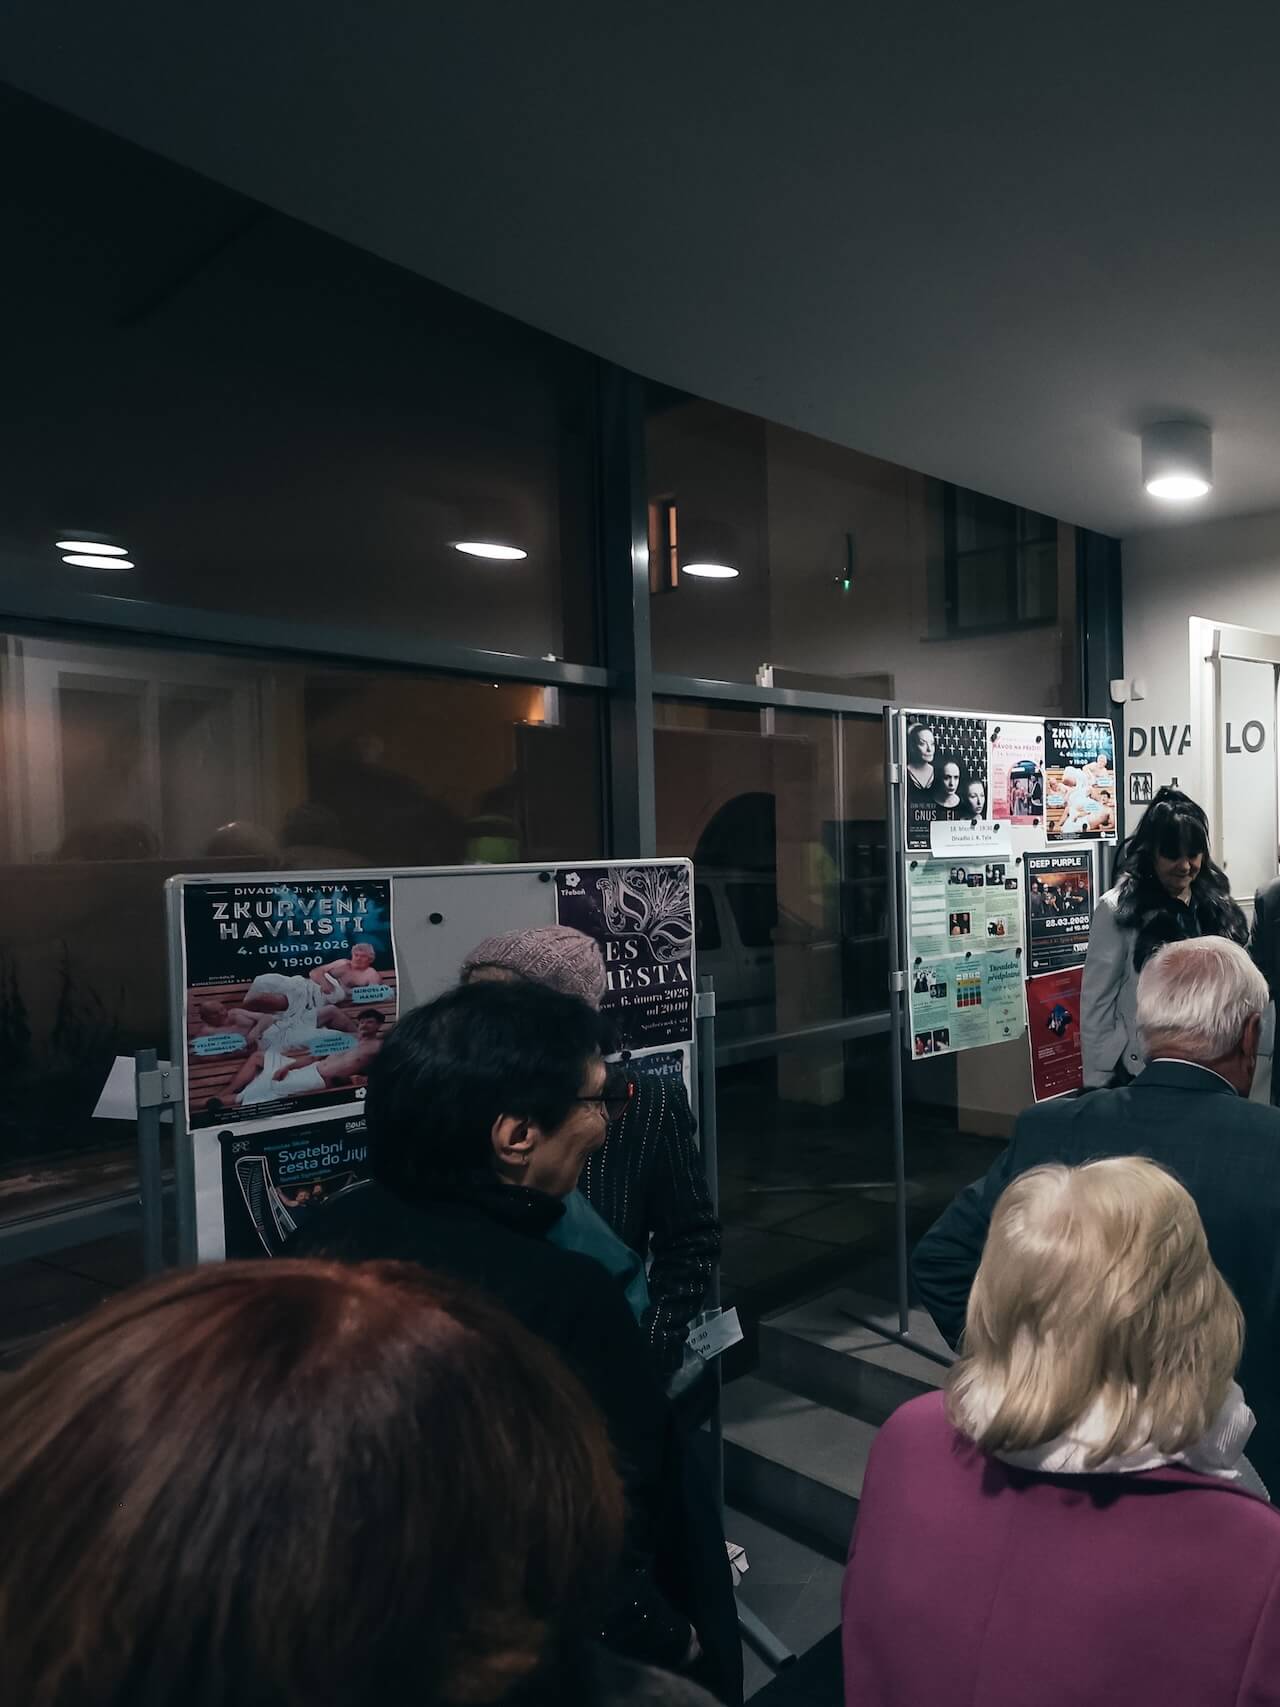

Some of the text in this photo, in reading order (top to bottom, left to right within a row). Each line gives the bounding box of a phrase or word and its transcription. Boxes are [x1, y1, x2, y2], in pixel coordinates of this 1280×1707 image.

[1054, 739, 1103, 749] HAVLISTI
[1128, 720, 1265, 757] DIVALO
[915, 810, 955, 821] GNUS EI
[1030, 858, 1081, 869] DEEP PURPLE
[234, 885, 290, 895] DIVADLO
[320, 885, 349, 893] TYLA
[212, 893, 369, 920] ZKURVENÍ
[219, 916, 364, 940] HAVLISTI
[237, 940, 350, 955] 4. dubna 2026
[606, 940, 638, 961] ES
[268, 955, 323, 969] v 19:00
[621, 996, 631, 1007] 6.
[634, 995, 662, 1005] února
[664, 987, 689, 1000] 2026
[646, 1005, 659, 1016] od
[278, 1139, 343, 1163] Svatební
[279, 1160, 318, 1175] cesta
[322, 1154, 340, 1166] do
